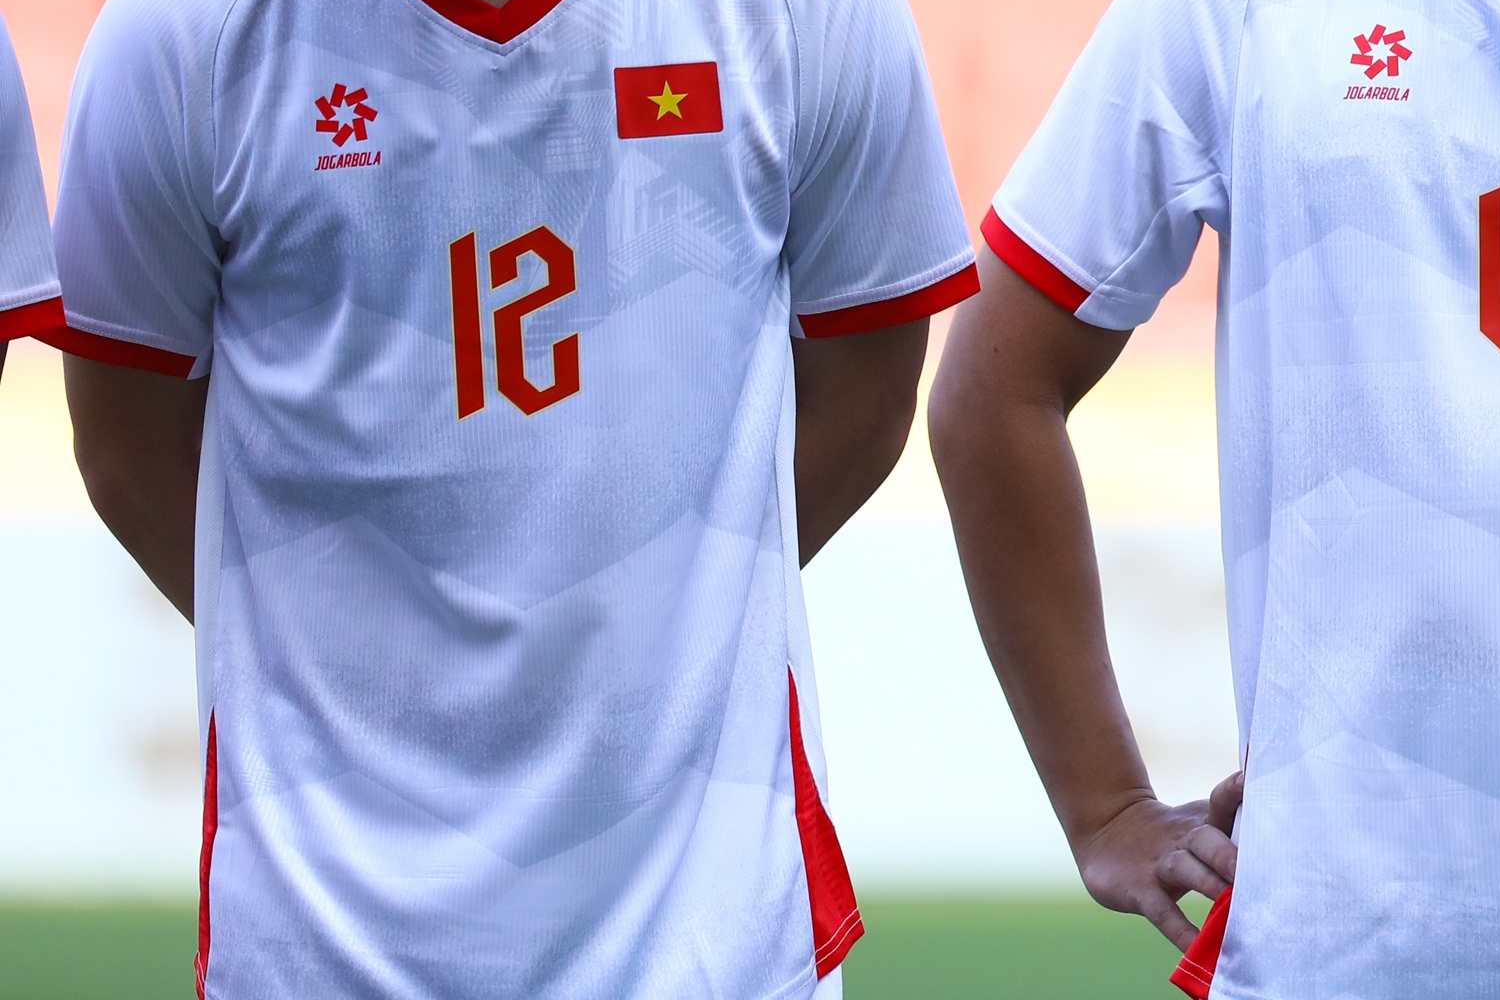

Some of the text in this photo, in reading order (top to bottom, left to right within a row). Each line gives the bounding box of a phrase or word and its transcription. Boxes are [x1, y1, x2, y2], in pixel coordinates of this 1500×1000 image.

[1343, 86, 1410, 101] JOGARBOLA
[314, 150, 382, 171] JOGARBOLA
[448, 224, 581, 421] 12
